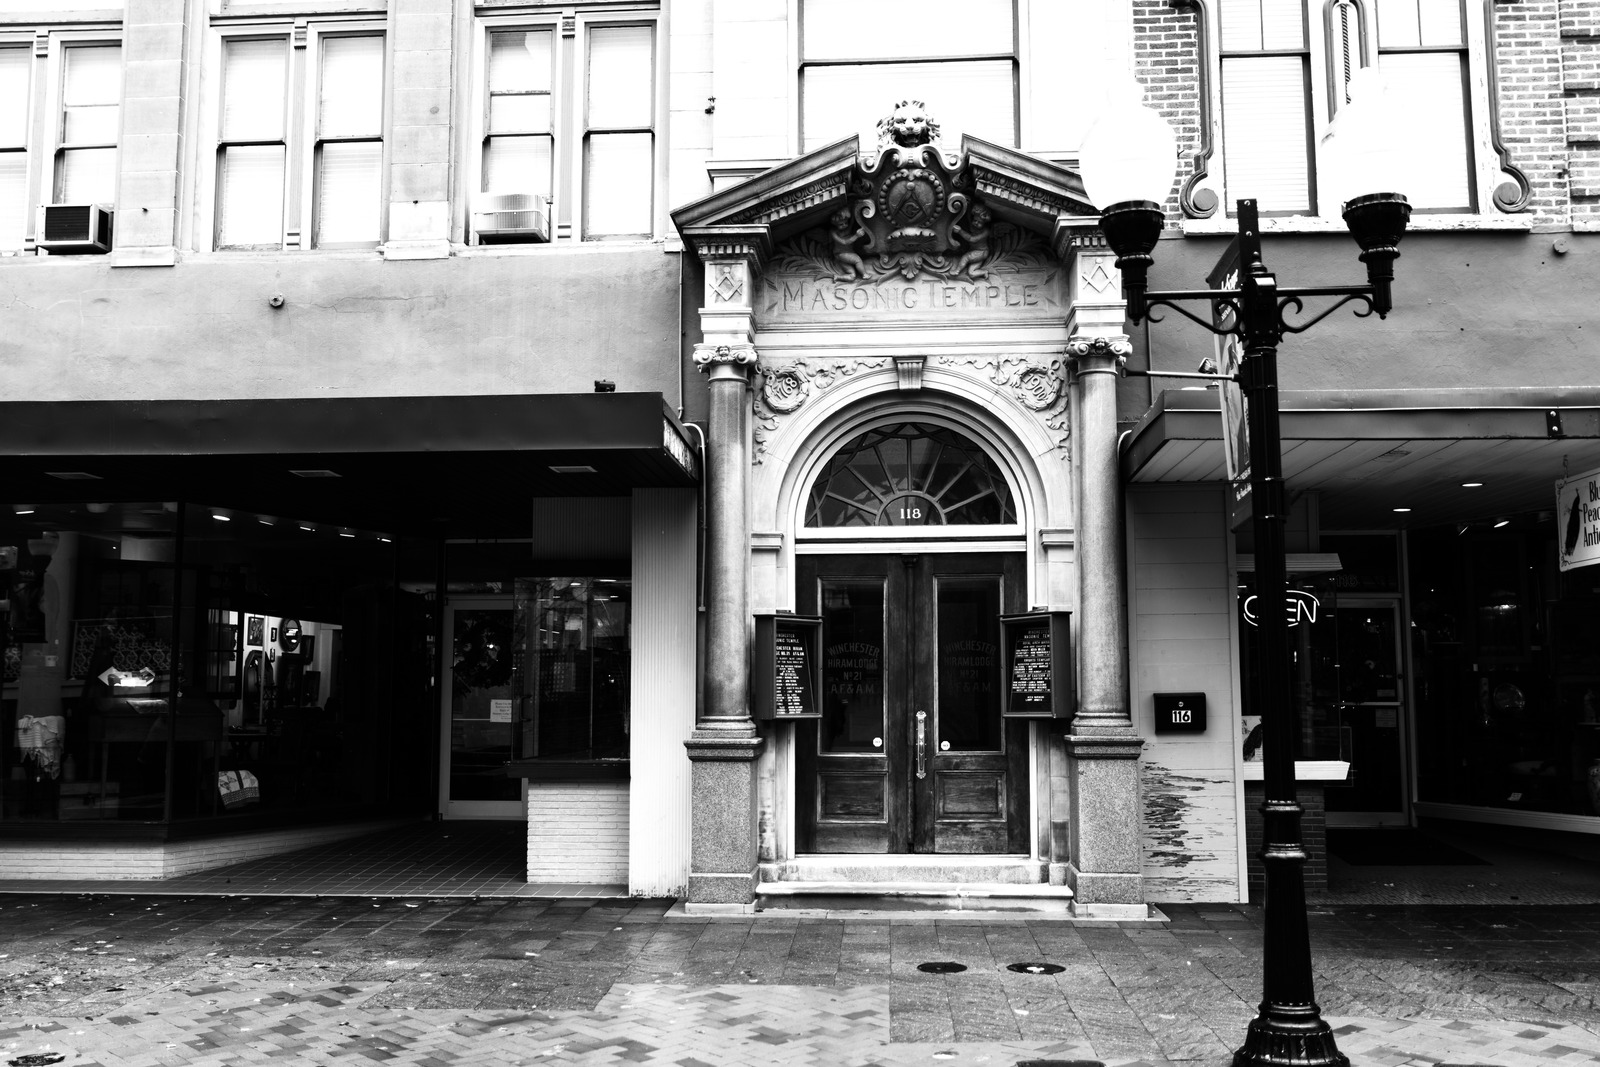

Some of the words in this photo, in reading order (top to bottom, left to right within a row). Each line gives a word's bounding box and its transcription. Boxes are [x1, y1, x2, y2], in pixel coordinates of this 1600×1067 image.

[782, 281, 918, 312] MASONIC
[921, 279, 1039, 308] TEMPLE
[900, 508, 921, 519] 118
[1244, 595, 1317, 624] OEN
[827, 642, 880, 658] WINCHESTER
[943, 640, 997, 656] WINCHESTER
[827, 658, 853, 668] HIRAM
[853, 658, 878, 669] LODGE
[943, 656, 970, 667] HIRAM
[970, 656, 995, 667] LODGE
[1173, 711, 1191, 723] 116
